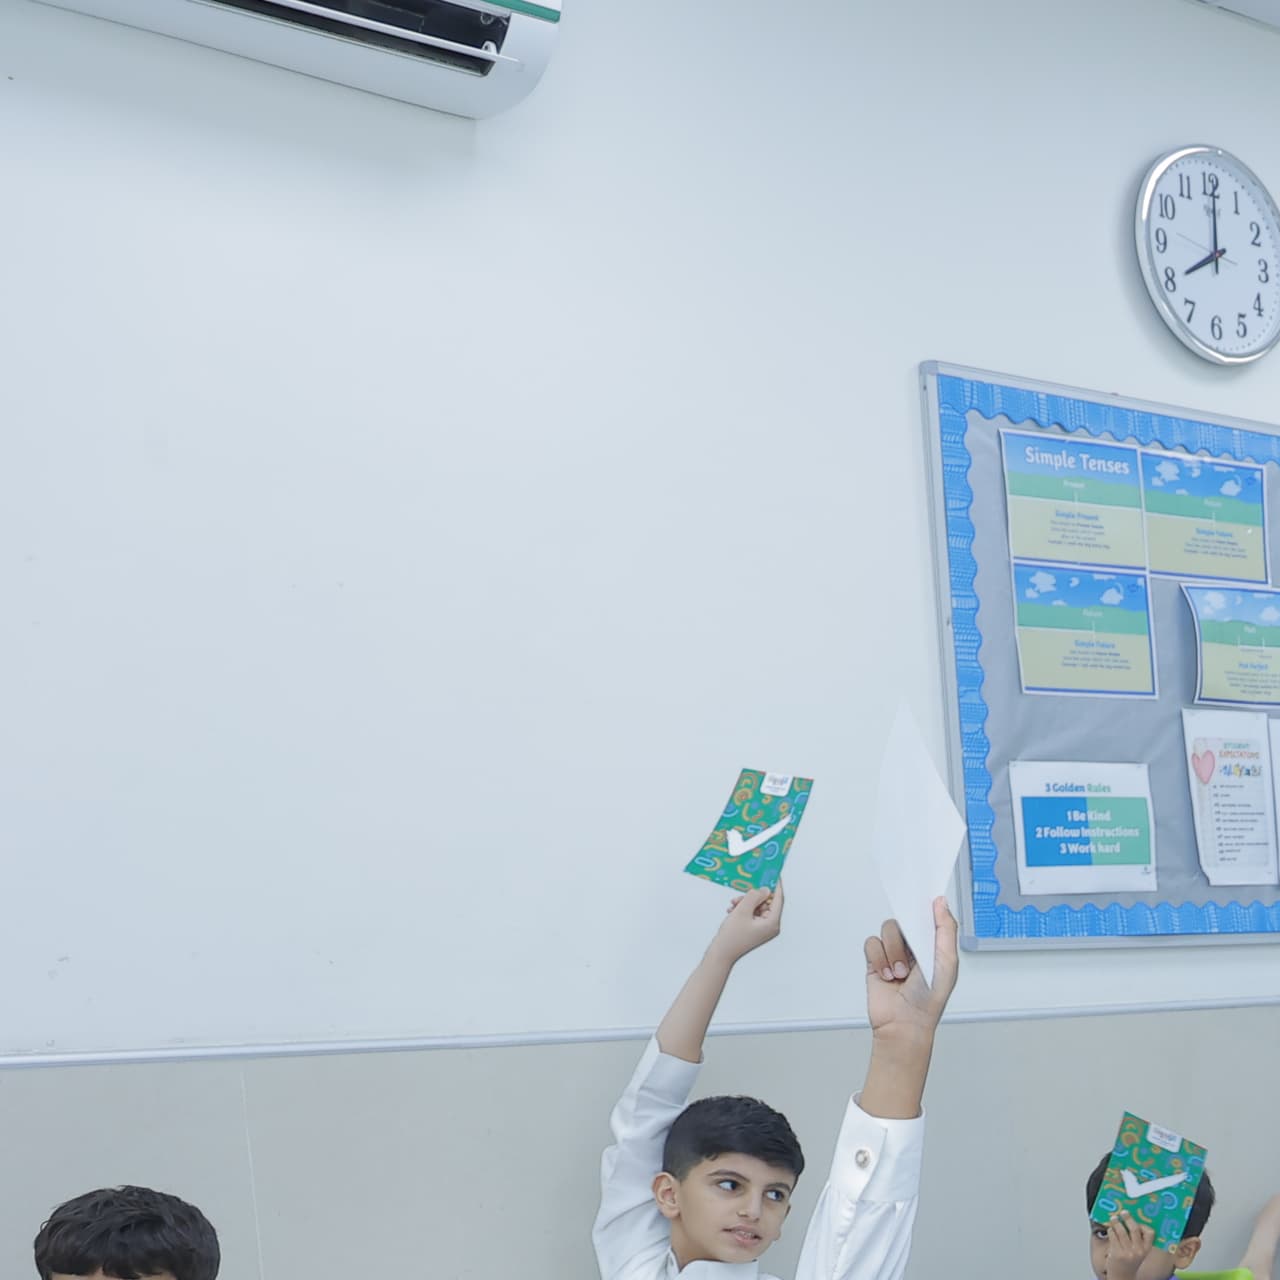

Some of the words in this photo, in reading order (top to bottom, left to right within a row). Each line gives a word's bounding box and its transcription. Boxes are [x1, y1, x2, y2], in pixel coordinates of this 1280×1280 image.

[1178, 173, 1192, 200] 11
[1201, 171, 1220, 199] 12
[1159, 193, 1176, 220] 10
[1233, 191, 1240, 215] 1
[1155, 228, 1167, 253] 9
[1249, 222, 1262, 247] 2
[1164, 266, 1176, 292] 8
[1257, 259, 1269, 283] 3
[1184, 298, 1196, 323] 7
[1253, 292, 1264, 317] 4
[1211, 315, 1223, 340] 6
[1236, 313, 1247, 338] 5
[1025, 446, 1076, 470] Simple
[1079, 453, 1130, 475] Tenses
[1045, 783, 1052, 793] 3
[1052, 783, 1085, 793] Golden
[1087, 783, 1111, 792] Rules
[1035, 827, 1043, 838] 2
[1044, 827, 1081, 838] Follow
[1060, 843, 1068, 854] 3
